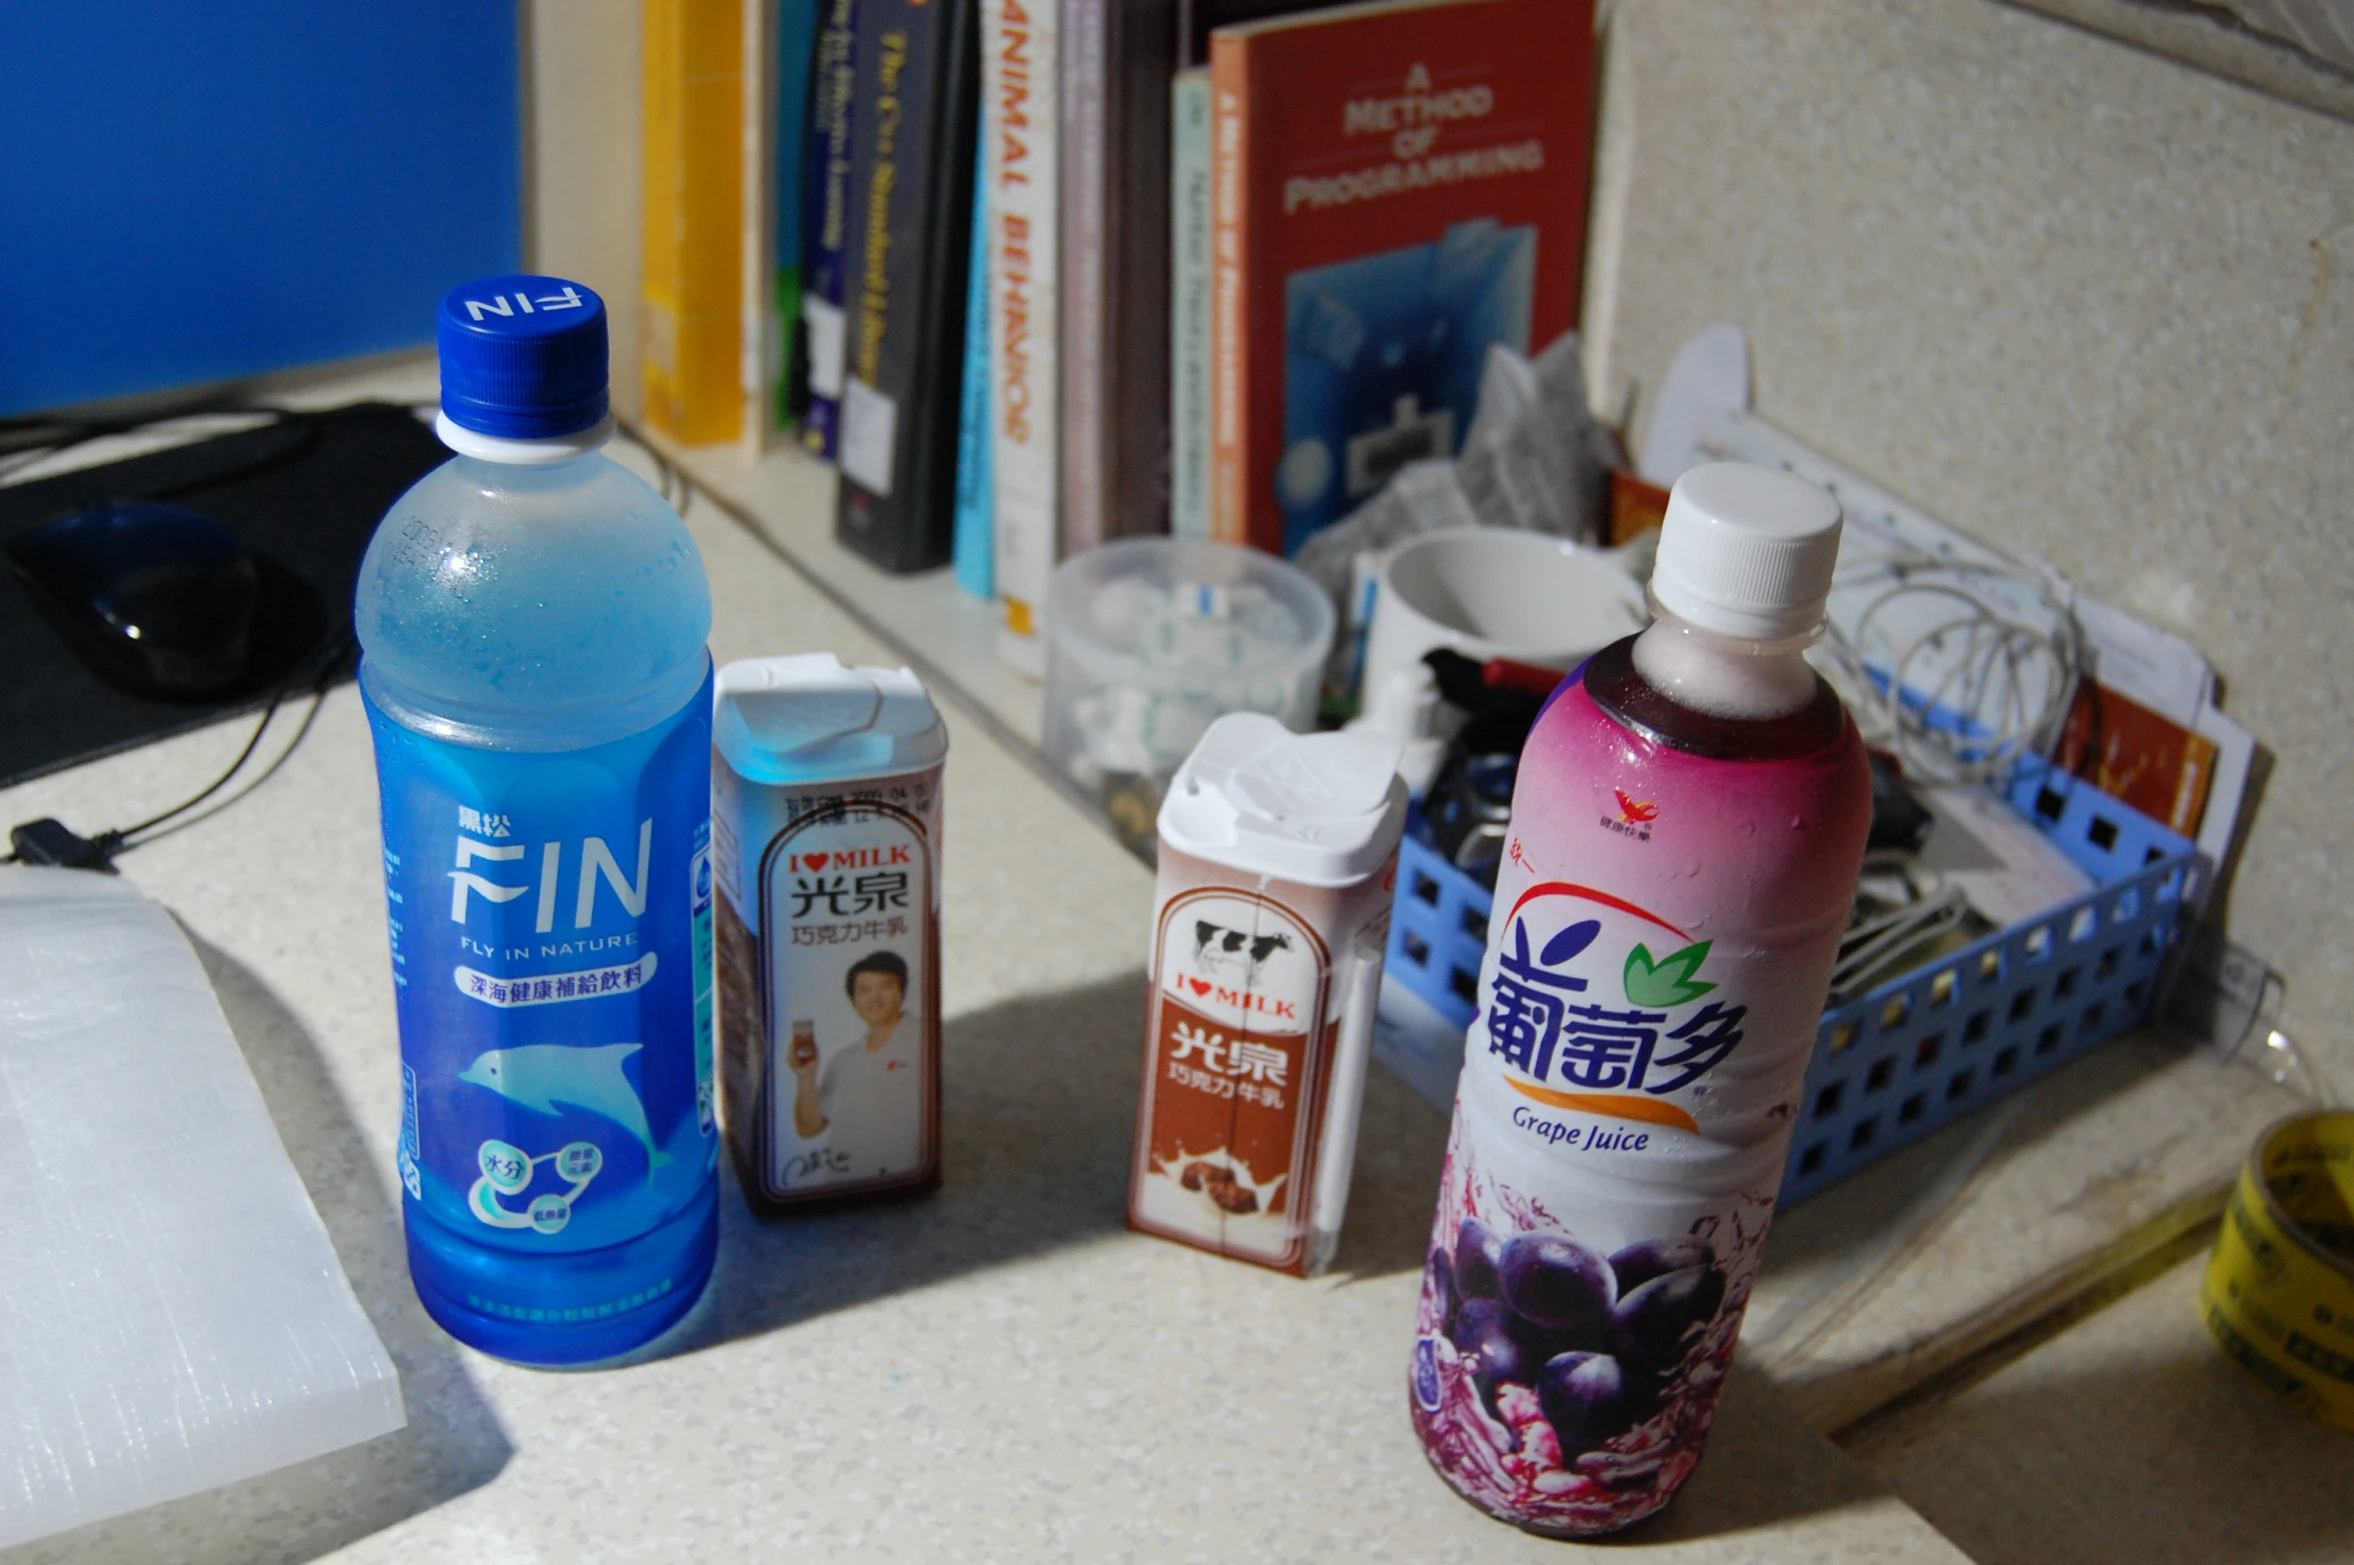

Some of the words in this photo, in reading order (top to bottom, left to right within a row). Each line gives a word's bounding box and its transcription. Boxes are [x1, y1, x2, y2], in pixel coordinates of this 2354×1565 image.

[996, 0, 1033, 192] ANIMAL
[1404, 62, 1432, 90] A
[464, 286, 583, 321] FIN
[1000, 213, 1033, 446] BEHAVIOR
[1600, 815, 1651, 842] 健康快樂
[446, 817, 653, 934] FIN
[788, 853, 800, 873] I
[833, 844, 912, 871] MILK
[791, 872, 909, 919] 光泉
[461, 936, 495, 959] FLY
[505, 947, 530, 961] IN
[541, 931, 639, 958] NATURE
[791, 915, 909, 947] 巧克力牛乳
[470, 964, 643, 1004] 深海健康補給飲料
[1177, 971, 1185, 989] I
[1215, 986, 1297, 1020] MILK
[1487, 915, 1748, 1095] 葡萄多
[1170, 1021, 1288, 1087] 光泉
[1168, 1061, 1286, 1110] 巧克力牛乳
[1513, 1105, 1581, 1145] Grape
[1581, 1124, 1650, 1151] Juice
[485, 1154, 526, 1180] 水分
